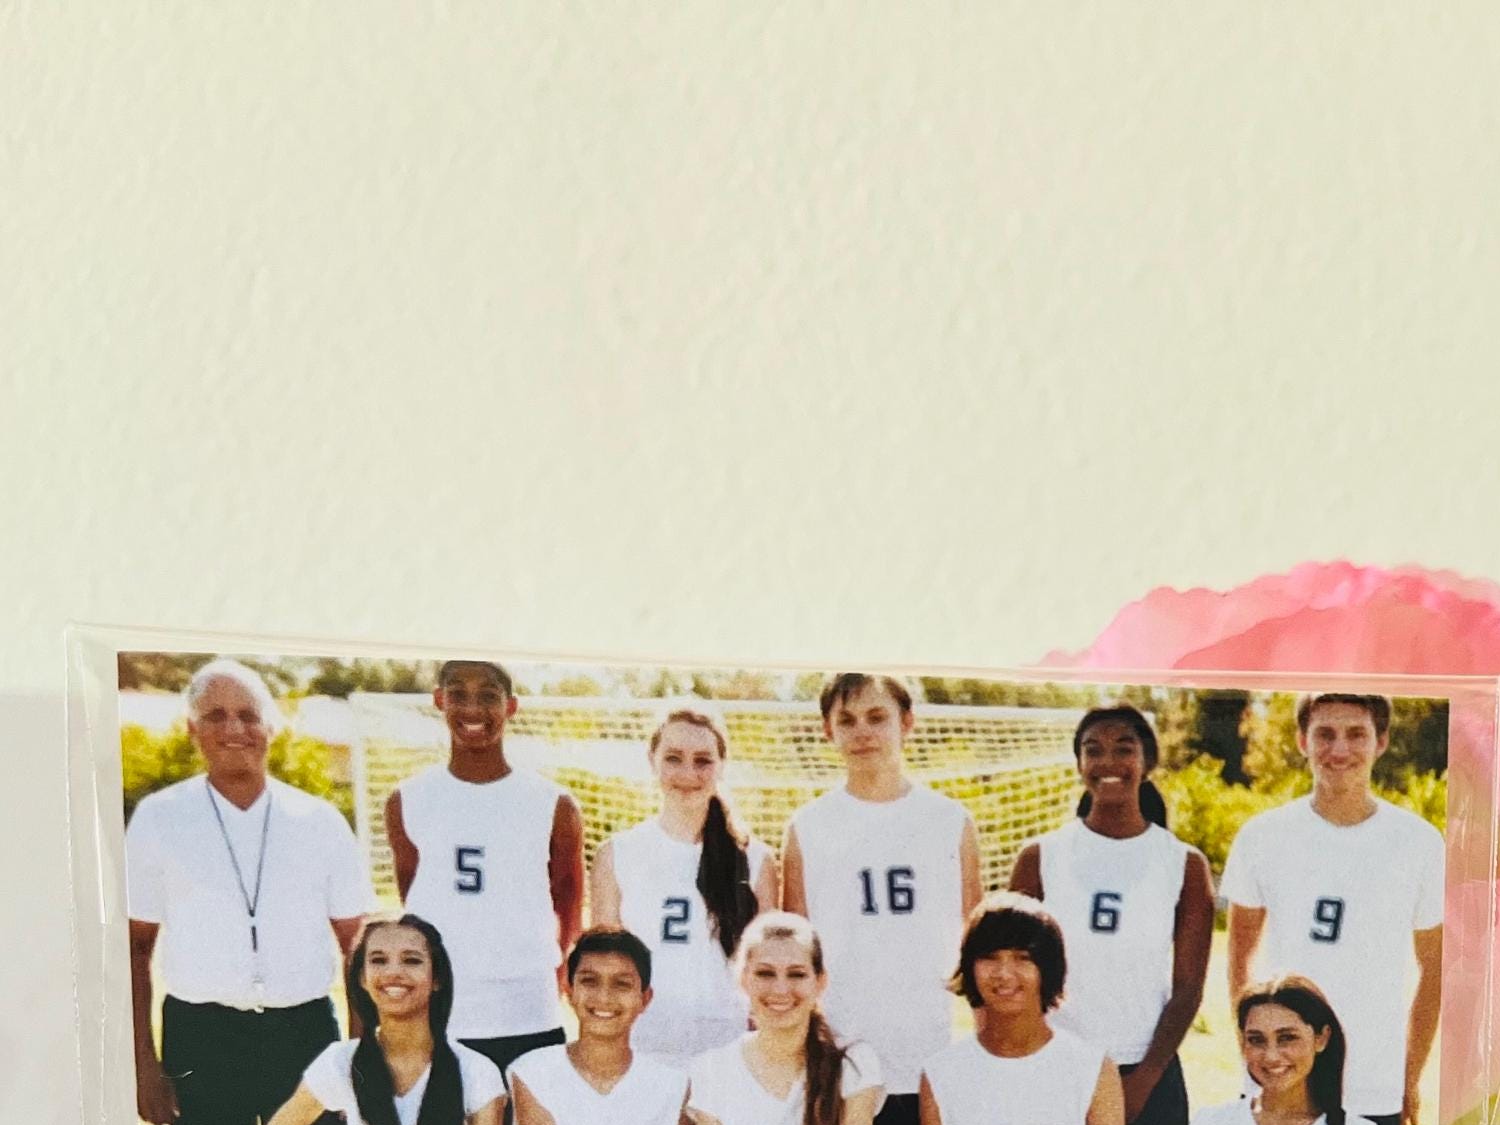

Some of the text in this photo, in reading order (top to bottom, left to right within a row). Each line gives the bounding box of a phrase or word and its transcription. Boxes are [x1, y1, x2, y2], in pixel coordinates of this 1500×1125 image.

[455, 846, 485, 895] 5
[858, 866, 915, 916] 16
[661, 896, 692, 944] 2
[1089, 891, 1123, 935] 6
[1309, 897, 1346, 945] 9
